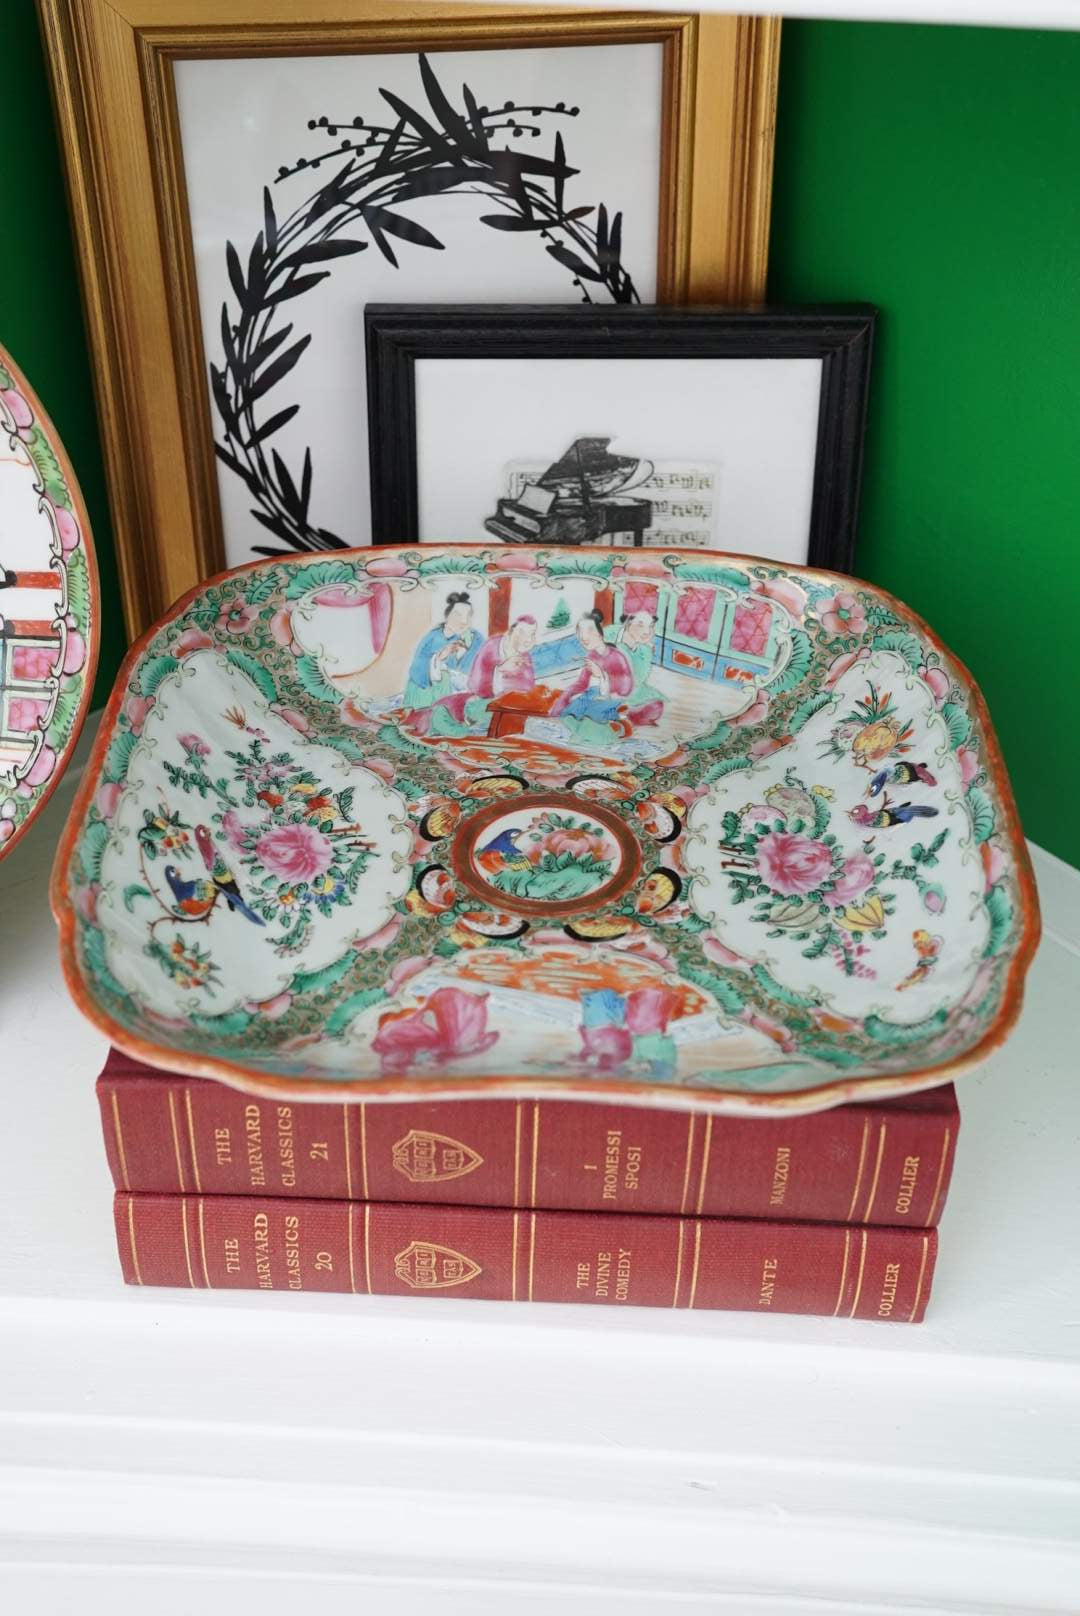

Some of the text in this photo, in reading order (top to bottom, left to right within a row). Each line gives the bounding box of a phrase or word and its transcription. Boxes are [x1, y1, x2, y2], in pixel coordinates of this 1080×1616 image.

[214, 1127, 232, 1165] THE
[245, 1104, 266, 1186] HARVARD
[277, 1106, 296, 1187] CLASSICS
[309, 1142, 328, 1160] 21
[602, 1130, 622, 1200] PROMESSI
[625, 1146, 642, 1190] SPOSI
[770, 1147, 791, 1205] MANZONI
[895, 1155, 920, 1214] COLLIER
[225, 1238, 240, 1273] THE
[254, 1213, 273, 1289] HARVARD
[285, 1216, 302, 1290] CLASSICS
[314, 1251, 333, 1272] 20
[576, 1262, 590, 1289] THE
[595, 1252, 611, 1297] DIVINE
[615, 1248, 632, 1301] COMEDY
[759, 1258, 778, 1305] DANTE
[878, 1262, 900, 1317] COLLIER
